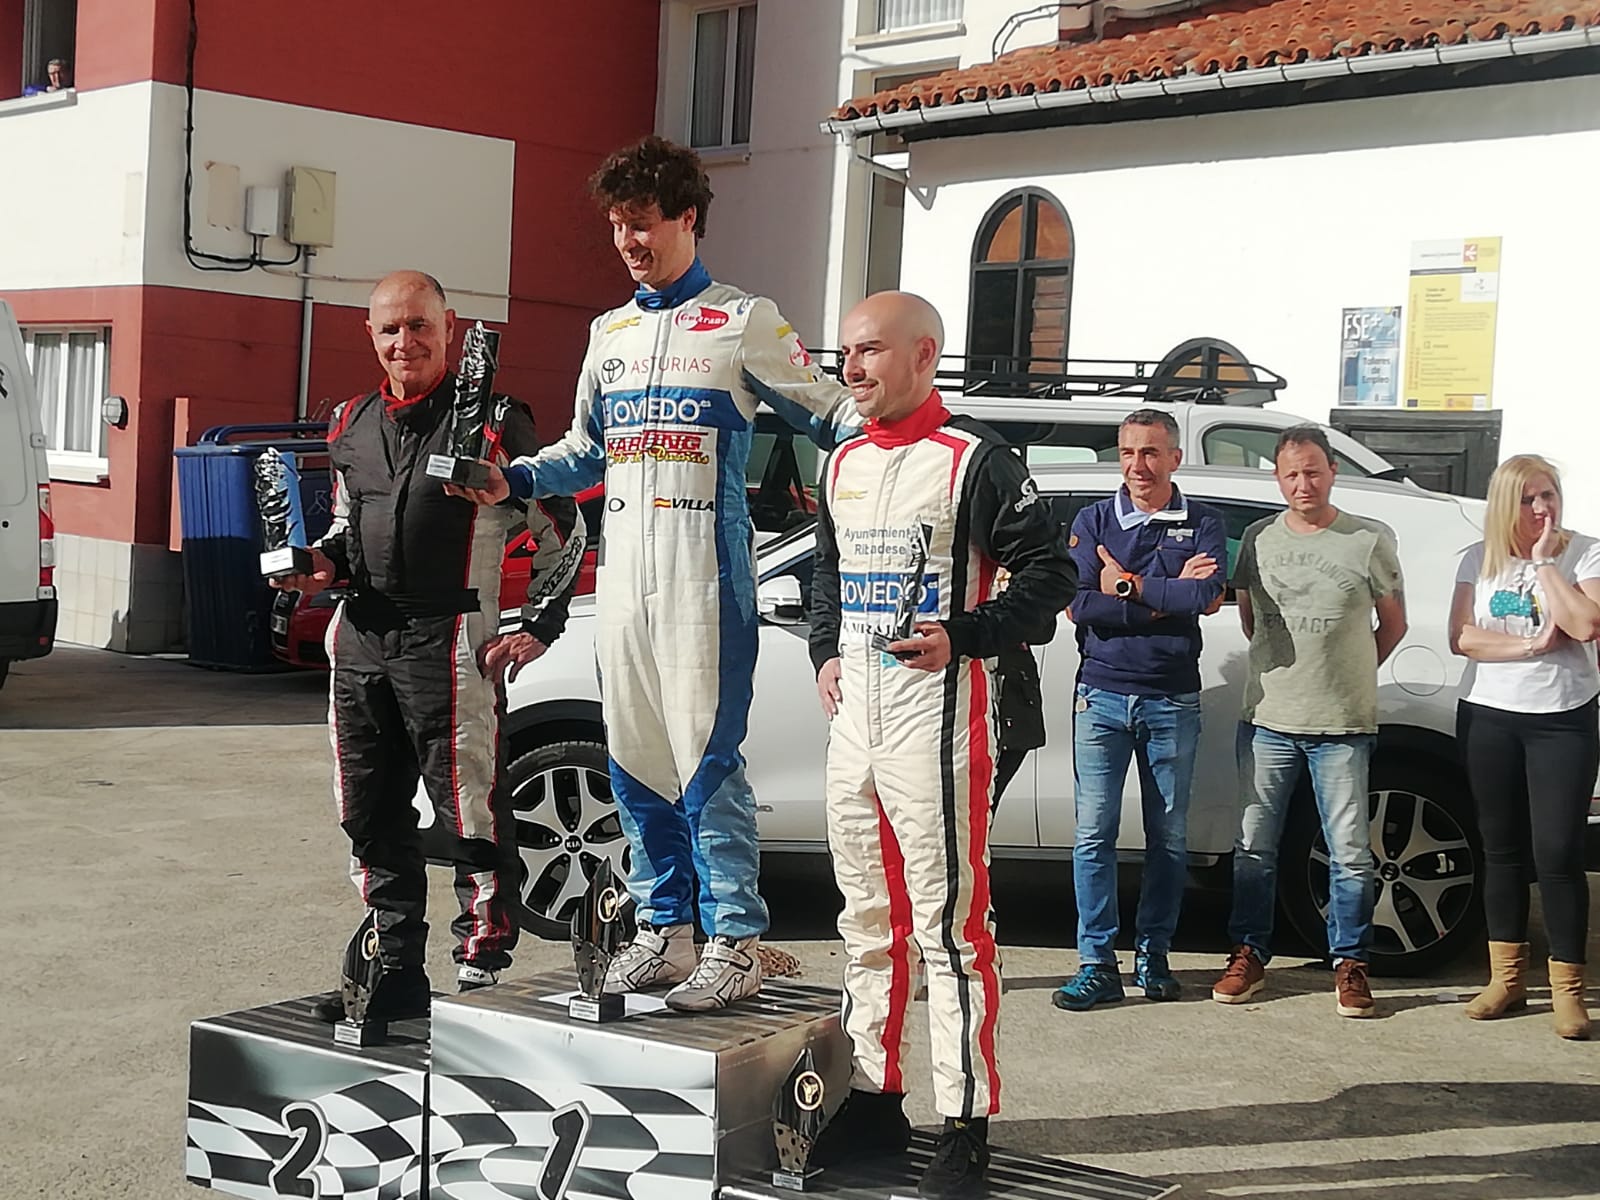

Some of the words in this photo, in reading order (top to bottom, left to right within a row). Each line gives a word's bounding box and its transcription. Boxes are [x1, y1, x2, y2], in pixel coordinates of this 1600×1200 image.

[631, 356, 712, 374] ASTURIAS
[614, 397, 700, 423] OVIEDO
[672, 498, 714, 511] VILLA
[566, 840, 581, 849] KIA
[270, 1102, 327, 1200] 2
